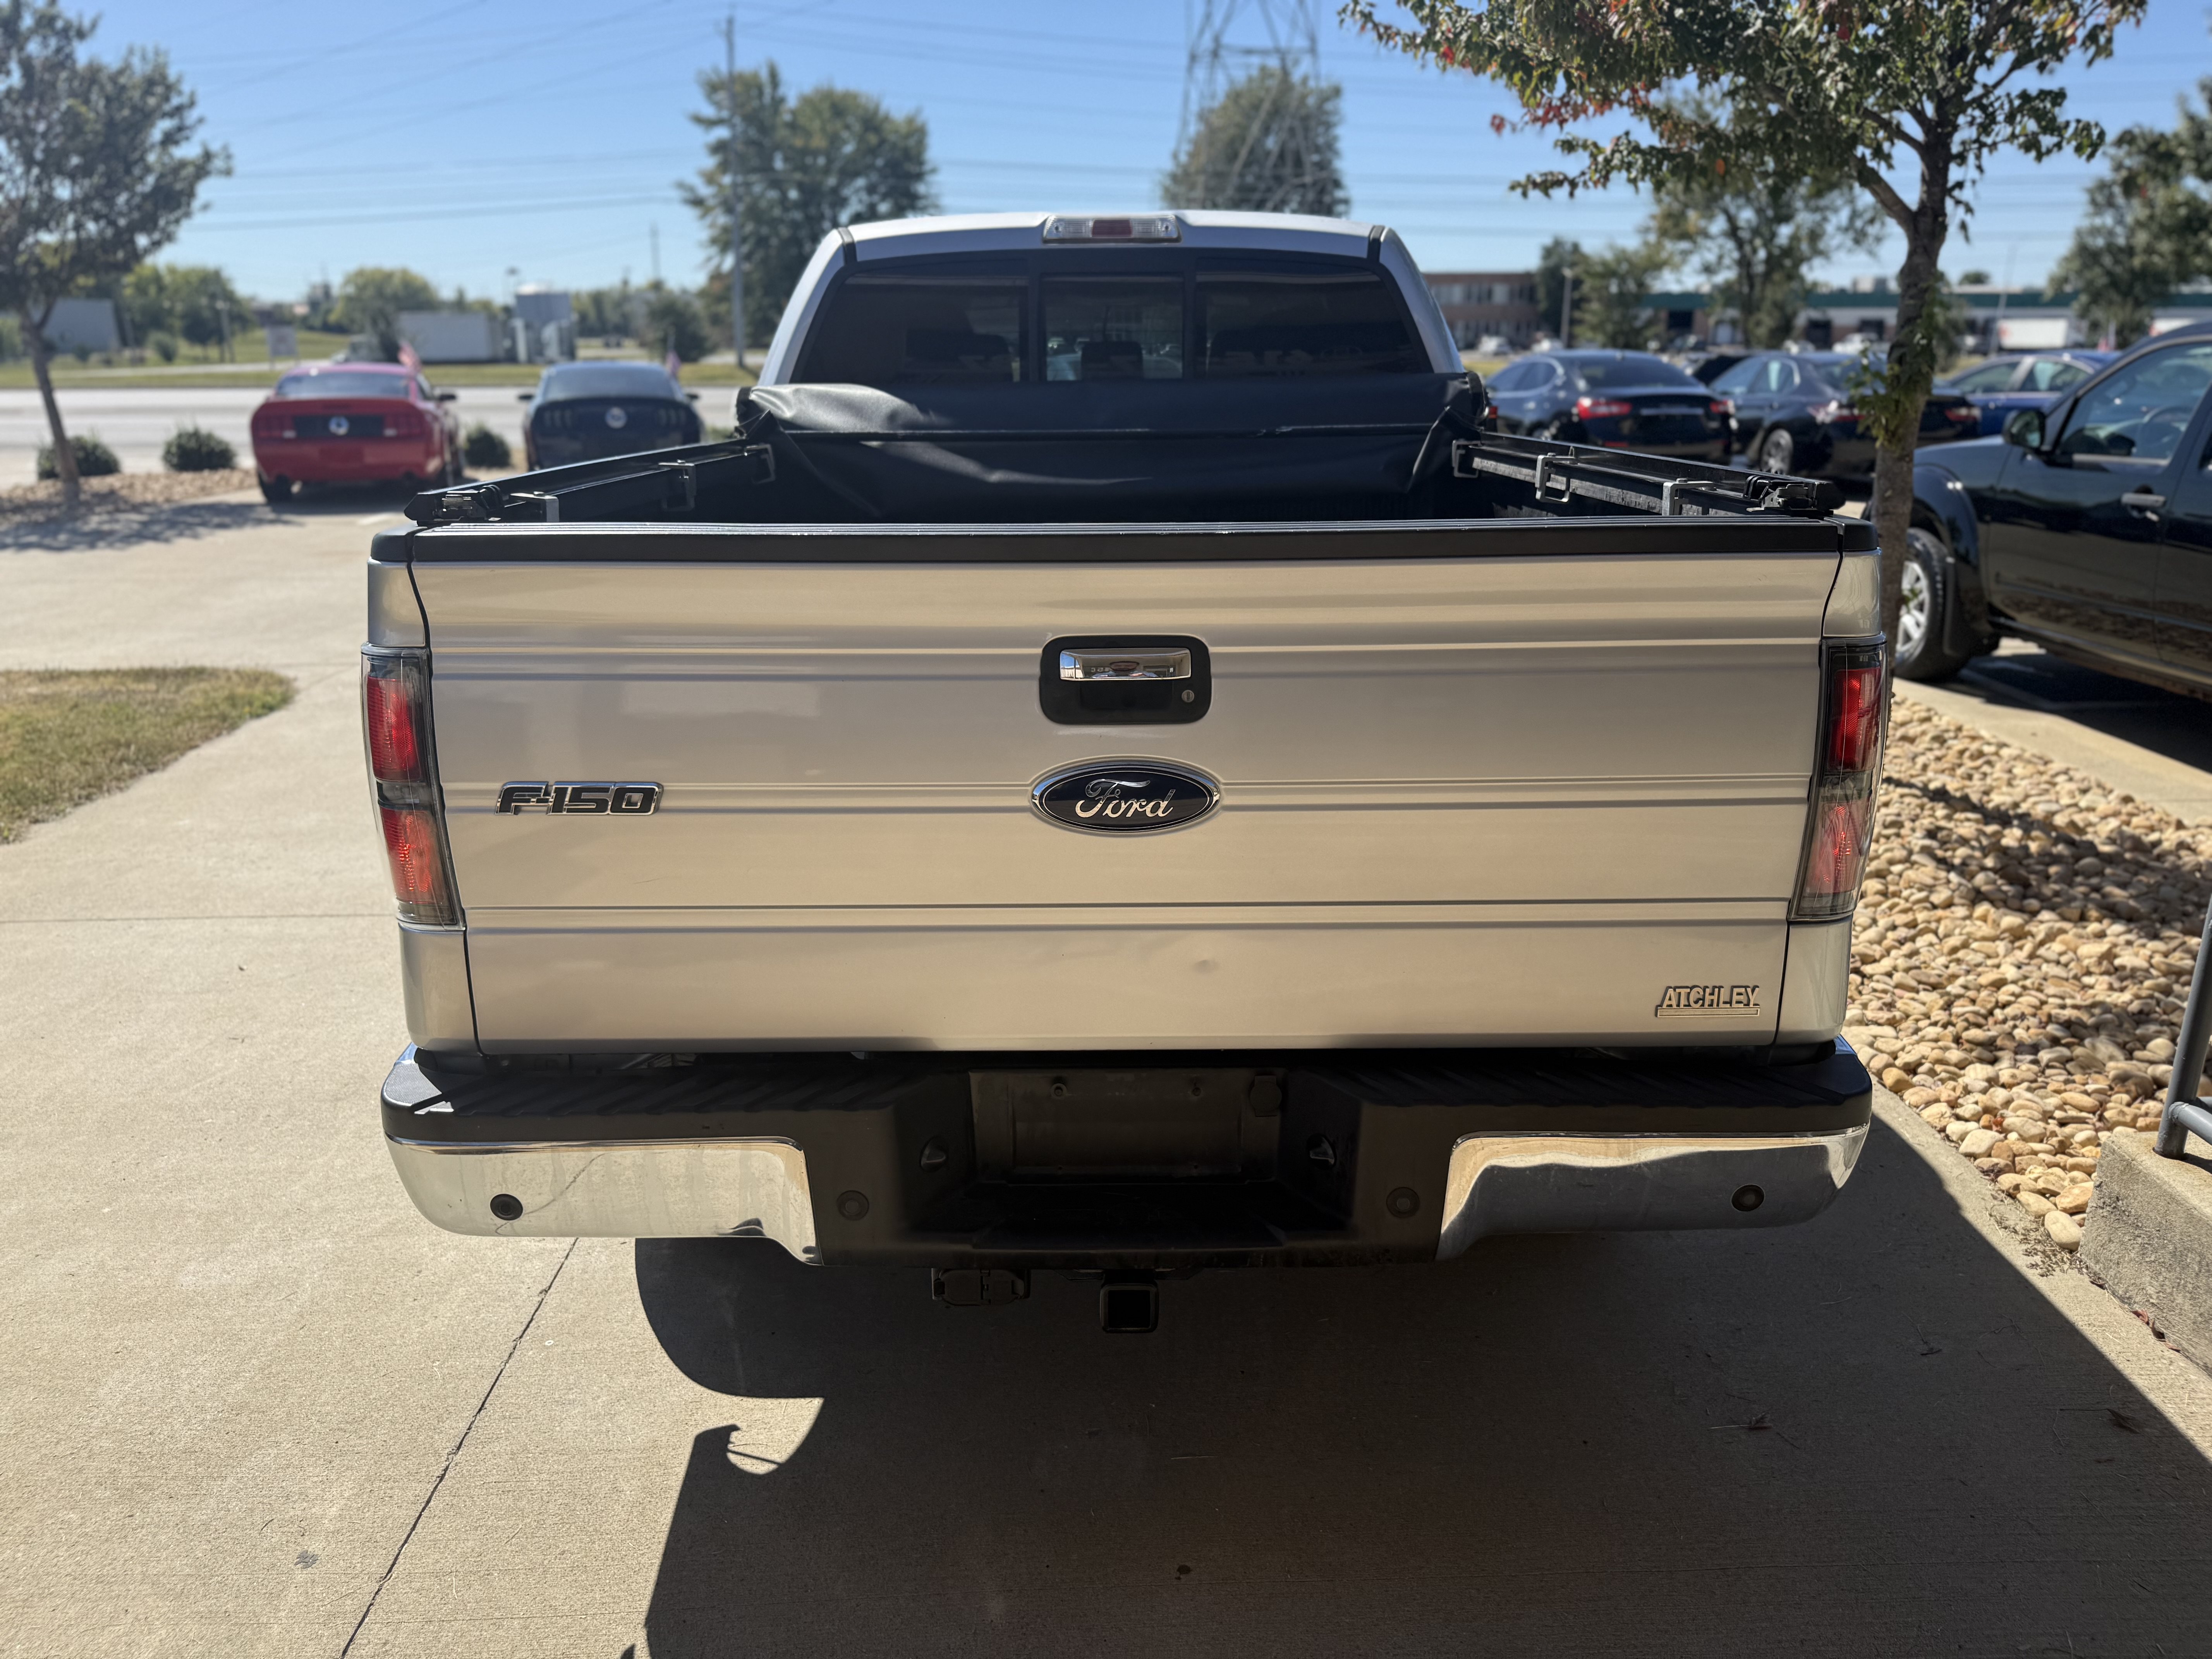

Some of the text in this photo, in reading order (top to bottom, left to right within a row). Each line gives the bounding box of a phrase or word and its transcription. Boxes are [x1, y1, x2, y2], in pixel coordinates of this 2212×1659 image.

[495, 781, 663, 815] F-150
[1075, 778, 1176, 818] Ford
[1661, 986, 1759, 1008] ATCHLEY
